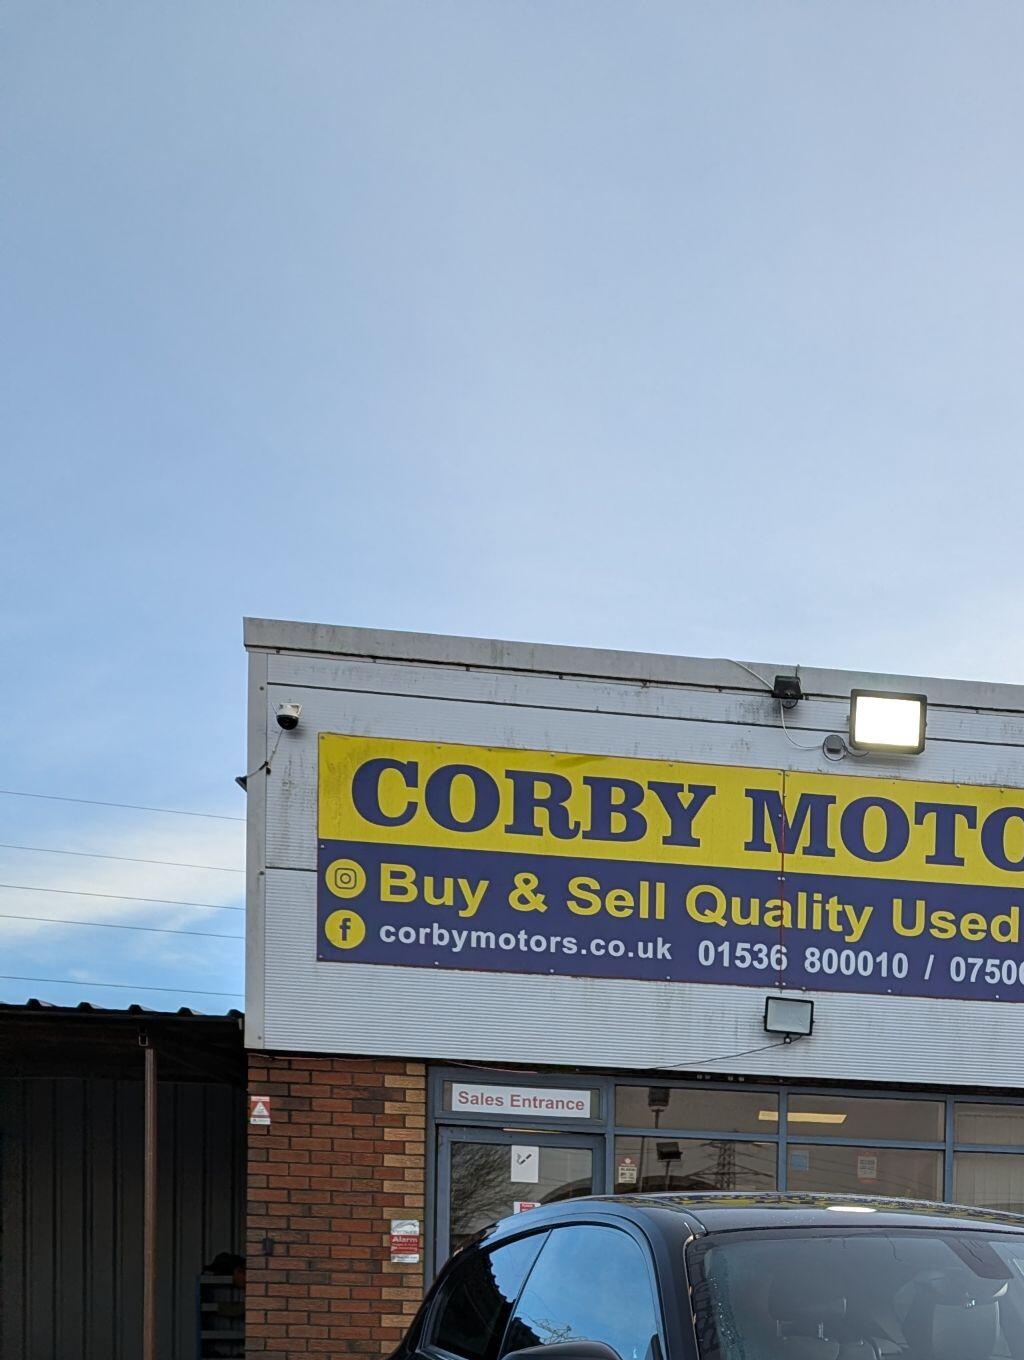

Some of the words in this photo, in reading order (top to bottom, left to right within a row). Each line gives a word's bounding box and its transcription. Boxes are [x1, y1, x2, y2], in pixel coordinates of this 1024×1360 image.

[351, 757, 716, 848] CORBY
[379, 862, 490, 918] Buy
[508, 872, 548, 913] &
[566, 876, 666, 919] Sell
[685, 884, 873, 943] Quality
[892, 897, 1020, 943] Used
[379, 922, 672, 960] corbymotors.co.uk
[698, 940, 788, 971] 01536
[804, 947, 909, 979] 800010
[924, 954, 934, 979] /
[458, 1091, 504, 1108] Sales
[509, 1094, 585, 1111] Entrance
[391, 1235, 418, 1243] Alarm
